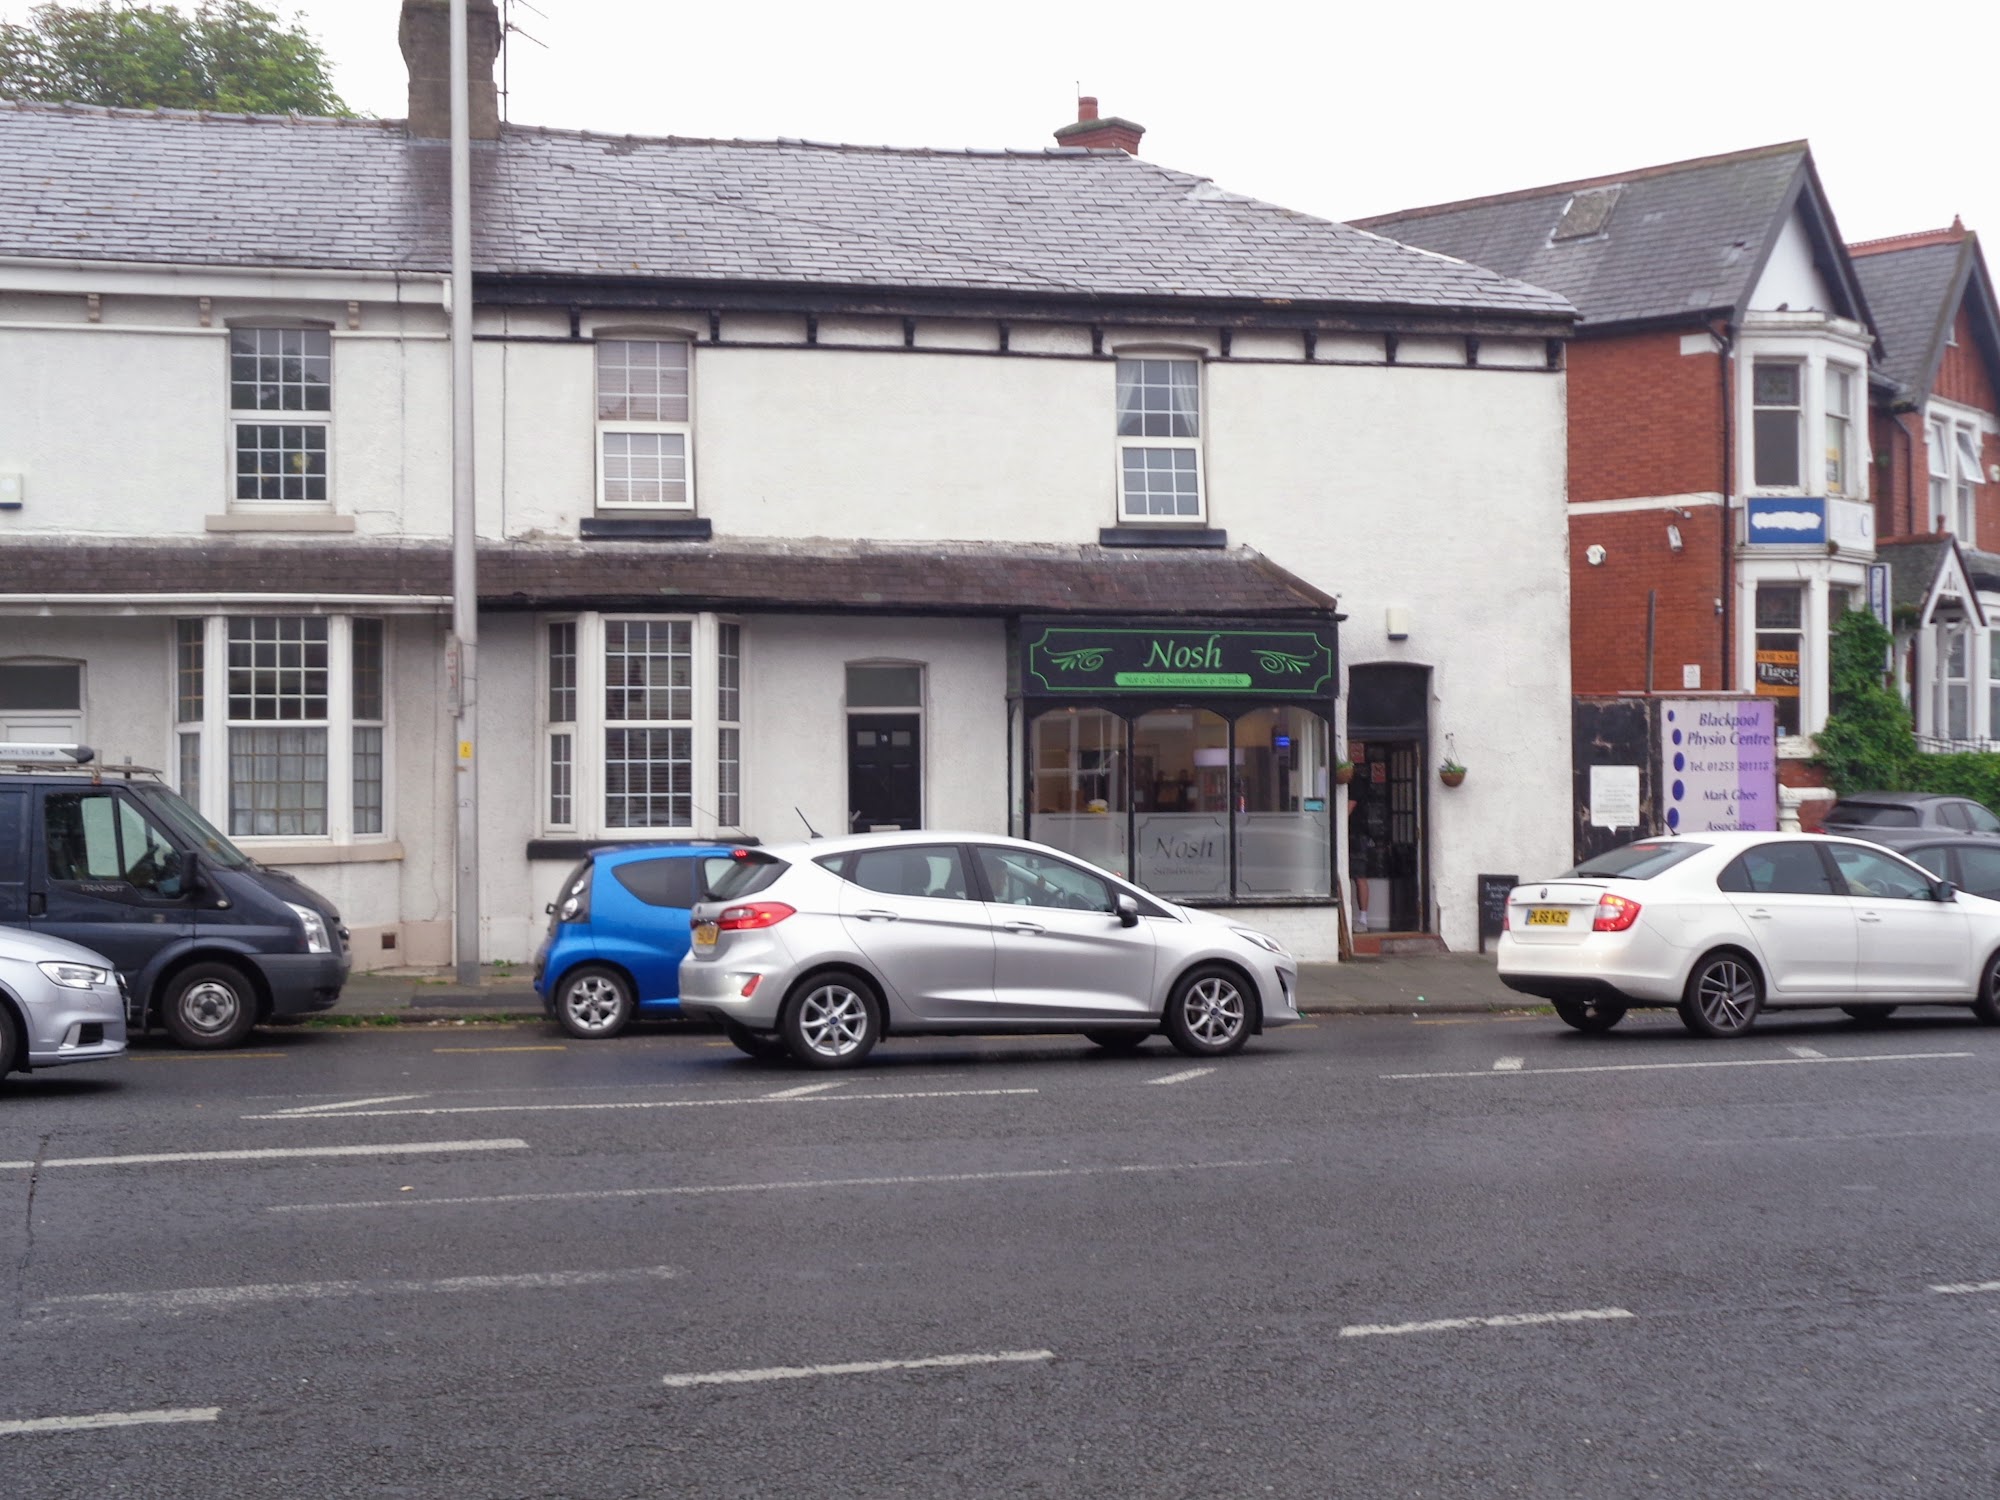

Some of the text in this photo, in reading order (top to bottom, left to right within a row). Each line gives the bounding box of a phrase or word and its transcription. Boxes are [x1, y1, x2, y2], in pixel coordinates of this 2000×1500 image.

[1142, 634, 1223, 669] Nosh
[1699, 712, 1759, 730] Blackpool
[1687, 731, 1771, 749] Physio Centre
[1707, 761, 1735, 772] 01253
[1704, 788, 1759, 801] Mark Ghee
[1726, 805, 1735, 816] &
[1707, 820, 1757, 831] Associates
[1150, 835, 1214, 859] Nosh
[81, 884, 127, 893] TRANSIT
